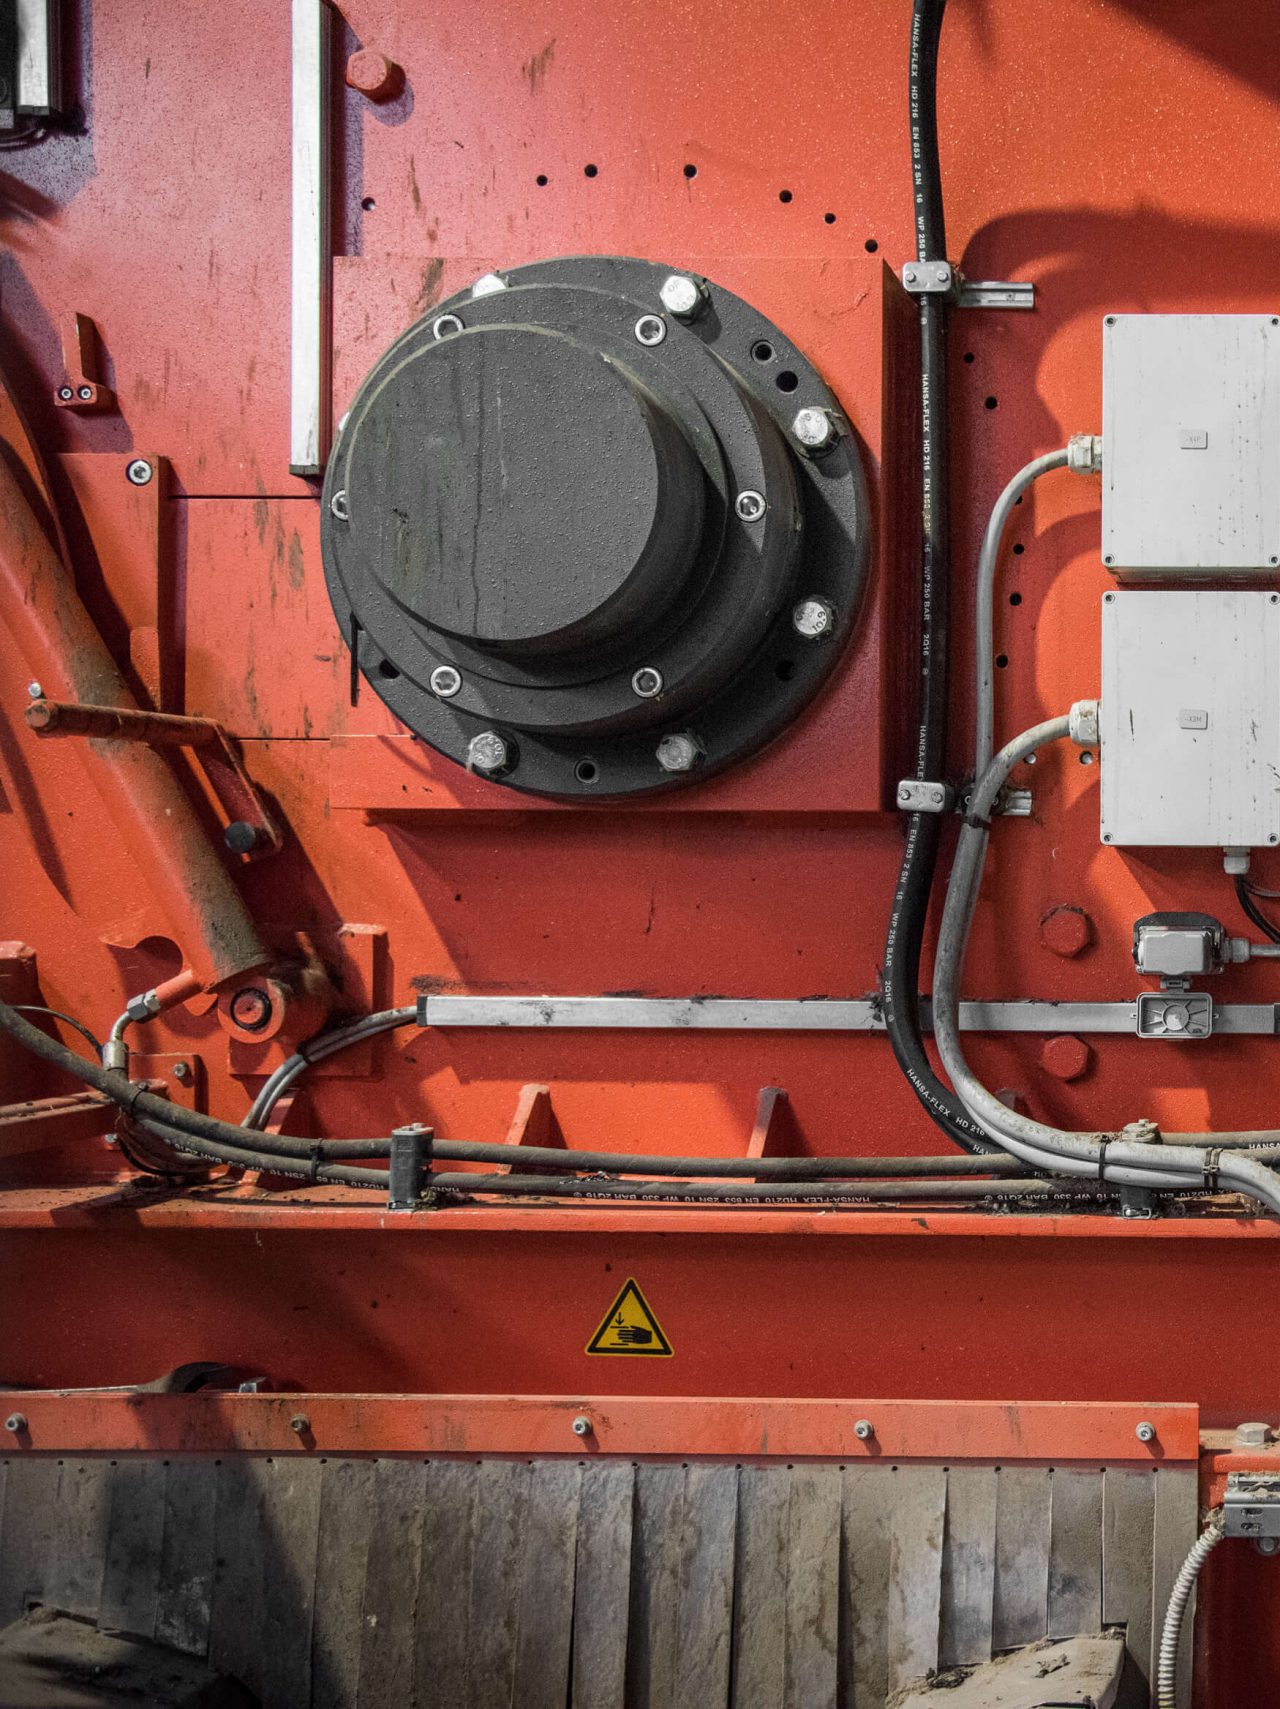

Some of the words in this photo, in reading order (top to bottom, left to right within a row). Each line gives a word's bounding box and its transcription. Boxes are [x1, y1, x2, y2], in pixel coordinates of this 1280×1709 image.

[911, 13, 921, 77] HANSA-FLEX
[911, 85, 918, 100] HD
[912, 126, 920, 140] EN
[914, 171, 922, 185] SN
[916, 192, 923, 204] 16
[917, 216, 925, 231] WP
[921, 374, 930, 432] HANSA-FLEX
[923, 440, 930, 453] HD
[923, 456, 931, 471] 216
[923, 478, 931, 491] EN
[917, 725, 927, 780] HANSA-FLE
[908, 829, 917, 842] EN
[905, 843, 914, 859] 853
[900, 870, 909, 883] SN
[890, 912, 899, 927] WP
[887, 929, 896, 945] 250
[885, 947, 894, 967] BAR
[906, 1068, 951, 1118] HANSA-FLEX
[955, 1116, 969, 1128] HD
[970, 1123, 986, 1136] 216
